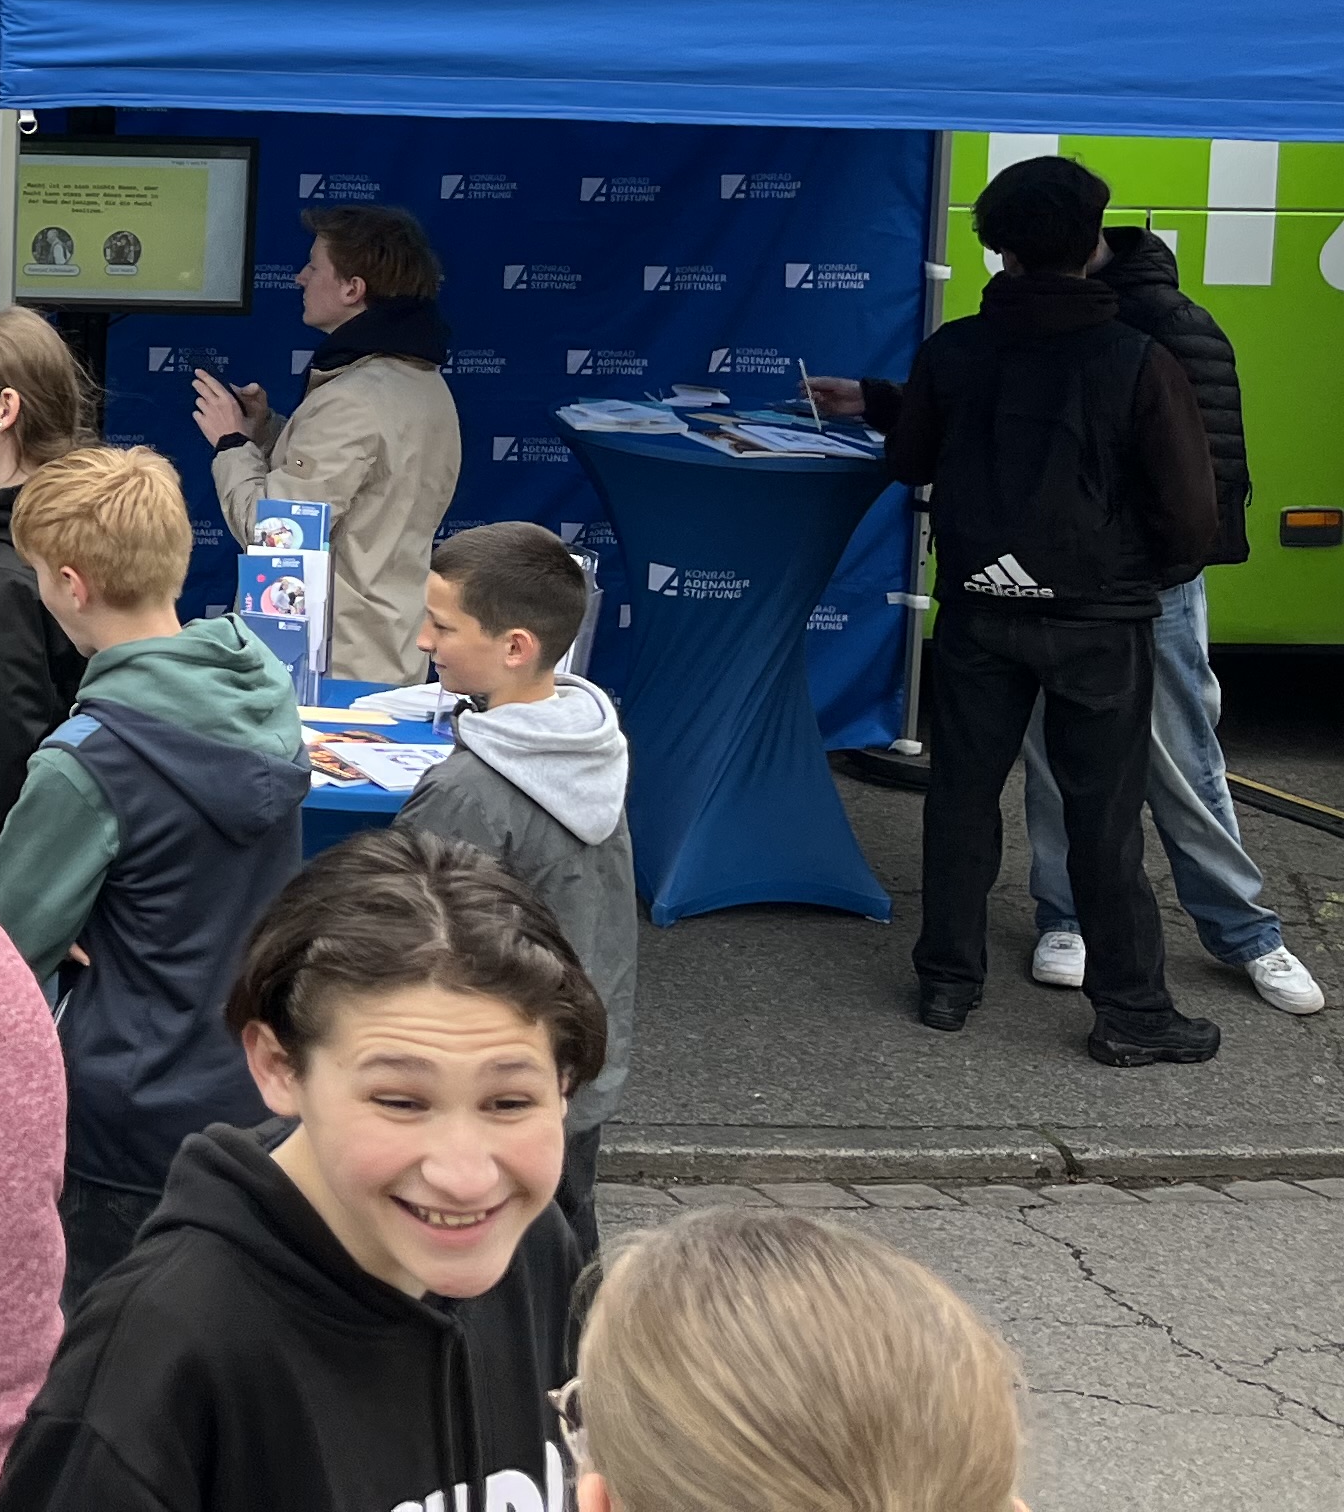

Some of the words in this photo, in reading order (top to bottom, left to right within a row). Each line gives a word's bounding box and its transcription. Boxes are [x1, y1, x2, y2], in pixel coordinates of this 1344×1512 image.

[329, 191, 375, 200] STIFTUNG
[818, 263, 858, 272] KONRAD
[817, 272, 870, 281] ADENAUER
[674, 282, 722, 291] STIFTUNG
[817, 280, 865, 289] STIFTUNG
[736, 348, 778, 357] KONRAD
[596, 358, 648, 367] ADENAUER
[735, 357, 791, 366] ADENAUER
[596, 366, 643, 376] STIFTUNG
[735, 365, 785, 374] STIFTUNG
[685, 570, 736, 580] KONRAD
[683, 579, 750, 589] ADENAUER
[683, 588, 742, 600] STIFTUNG
[964, 581, 1054, 598] adidas
[806, 621, 843, 631] IFTUNG
